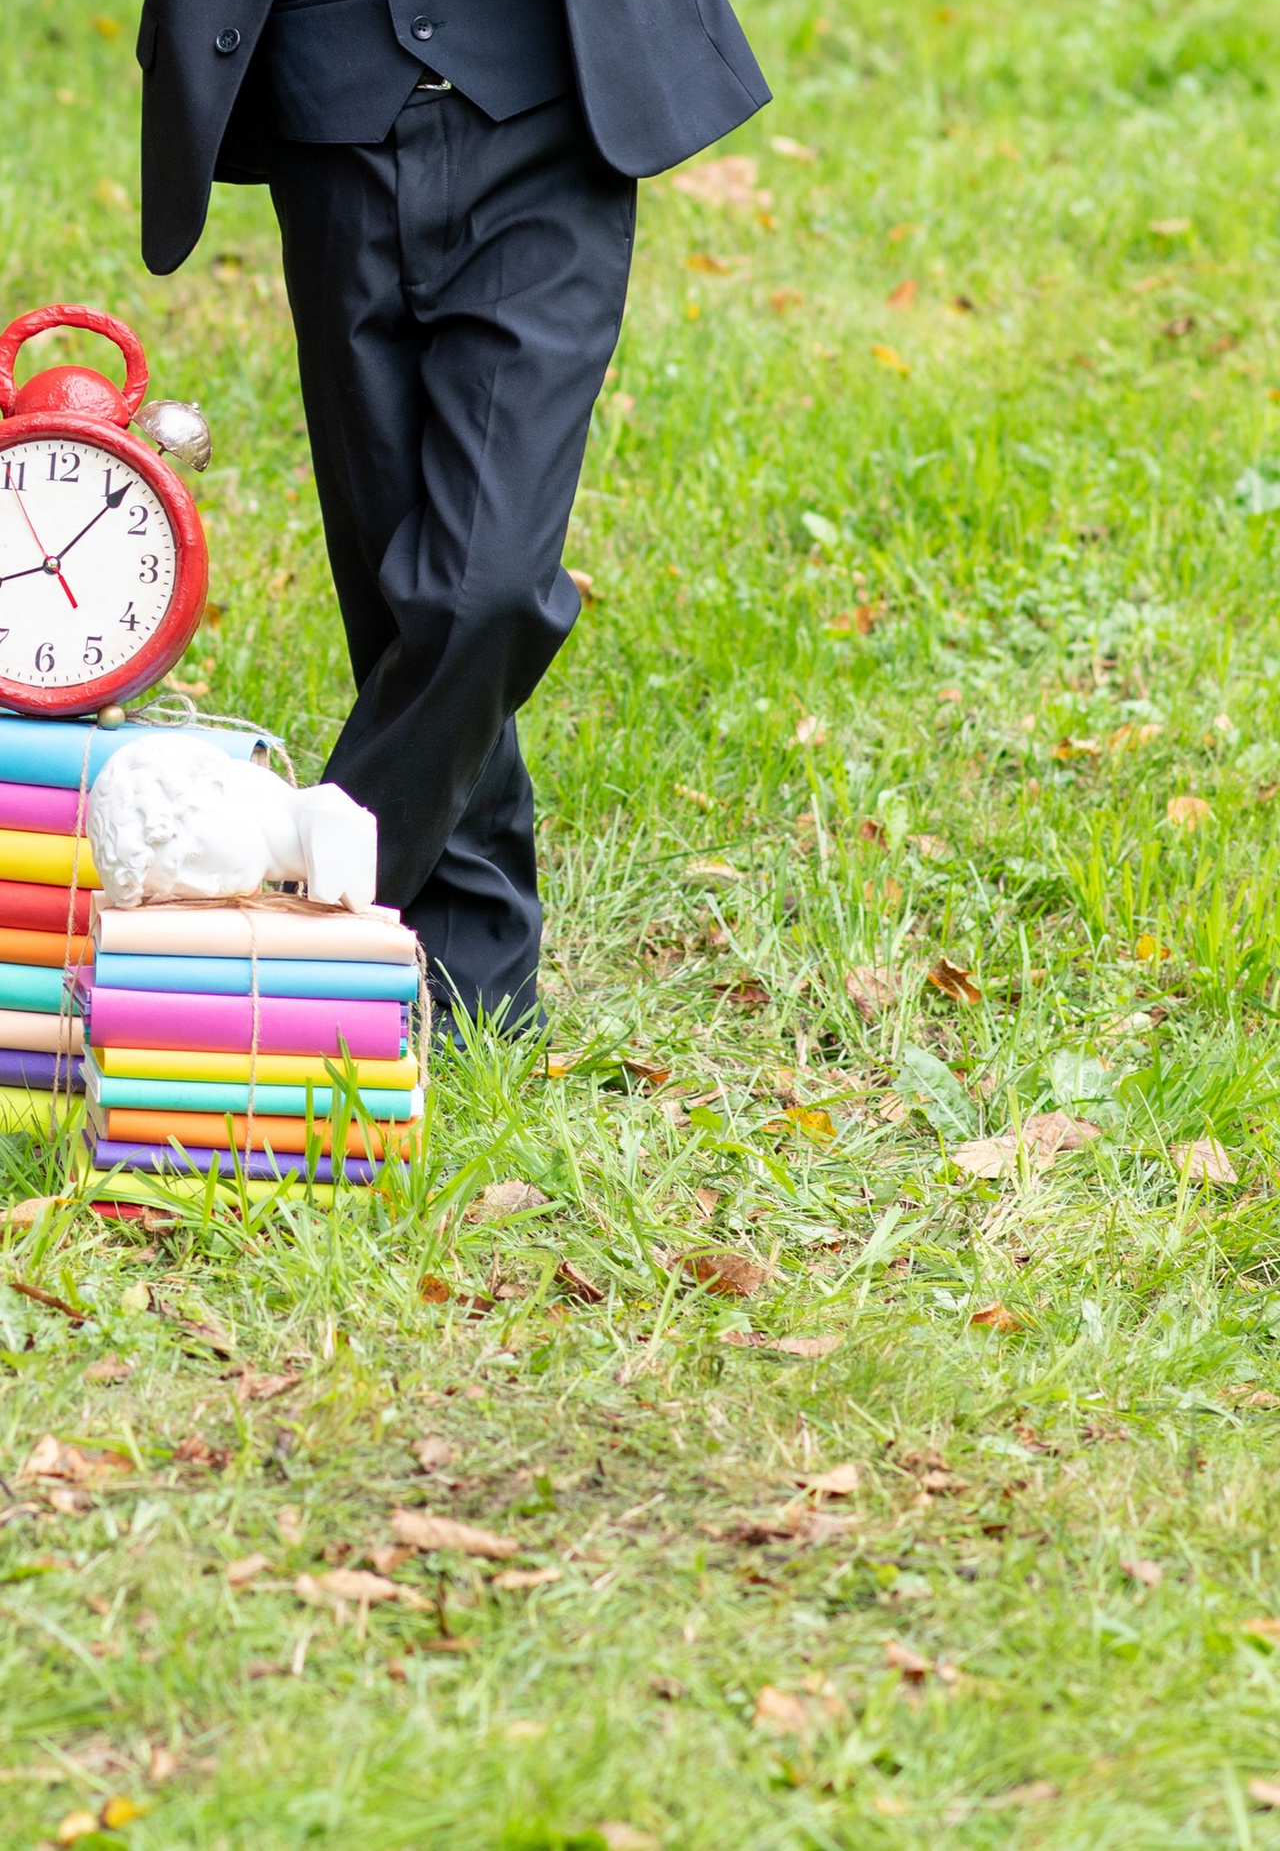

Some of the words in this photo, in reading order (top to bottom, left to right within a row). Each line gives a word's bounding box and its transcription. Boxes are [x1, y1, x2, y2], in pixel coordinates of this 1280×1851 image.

[0, 460, 26, 490] 11
[45, 451, 79, 481] 12
[100, 467, 113, 497] 1
[127, 504, 148, 535] 2
[138, 553, 158, 583] 3
[119, 601, 139, 631] 4
[35, 642, 54, 672] 6
[82, 635, 103, 664] 5
